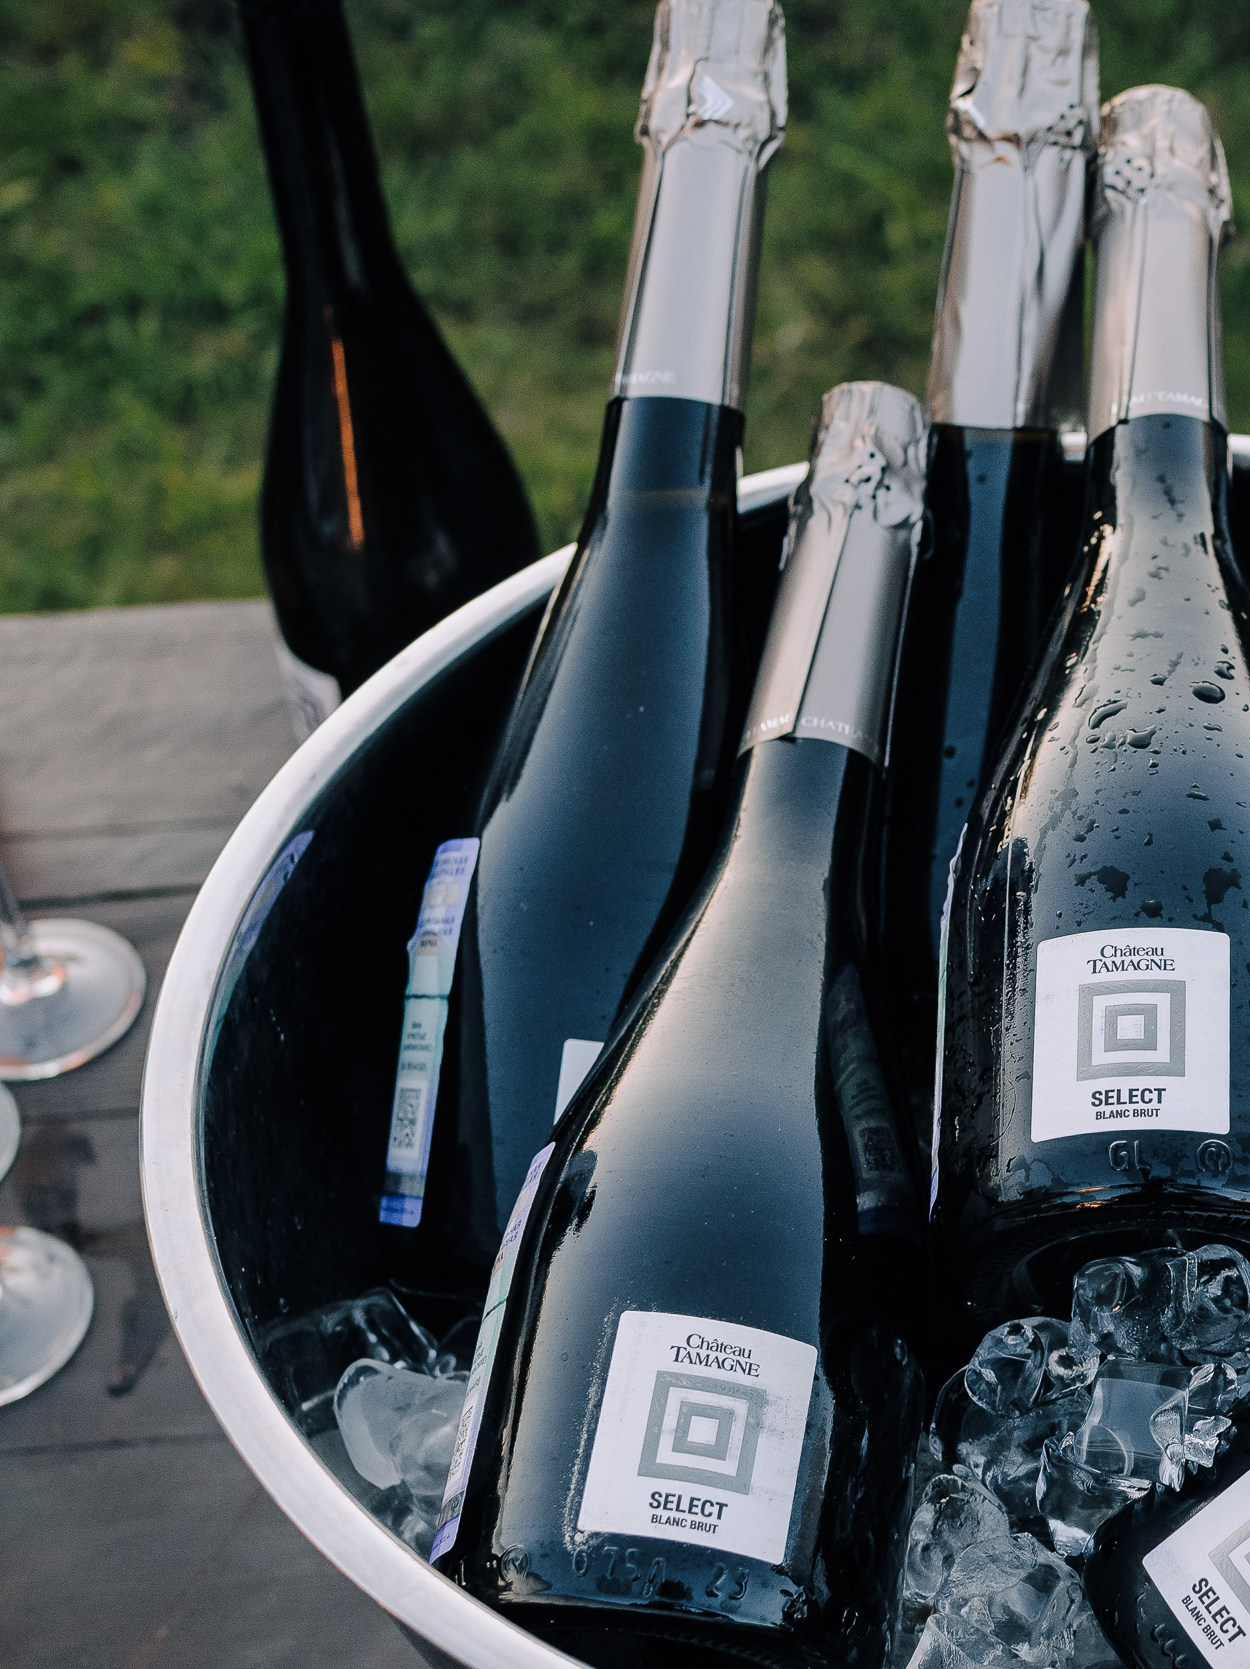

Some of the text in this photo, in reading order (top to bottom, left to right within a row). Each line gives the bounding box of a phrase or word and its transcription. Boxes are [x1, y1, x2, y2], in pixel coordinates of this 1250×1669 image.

[1099, 944, 1165, 959] Château
[1086, 958, 1176, 975] TAMAGNE
[1090, 1087, 1167, 1107] SELECT
[1095, 1108, 1161, 1121] BLANC BRUT
[686, 1333, 752, 1359] Château
[670, 1345, 760, 1378] TAMAGNE
[648, 1490, 728, 1521] SELECT
[650, 1513, 719, 1534] BLANC BRUT
[1191, 1577, 1247, 1643] SELECT
[1181, 1594, 1225, 1650] BLANC BRUT
